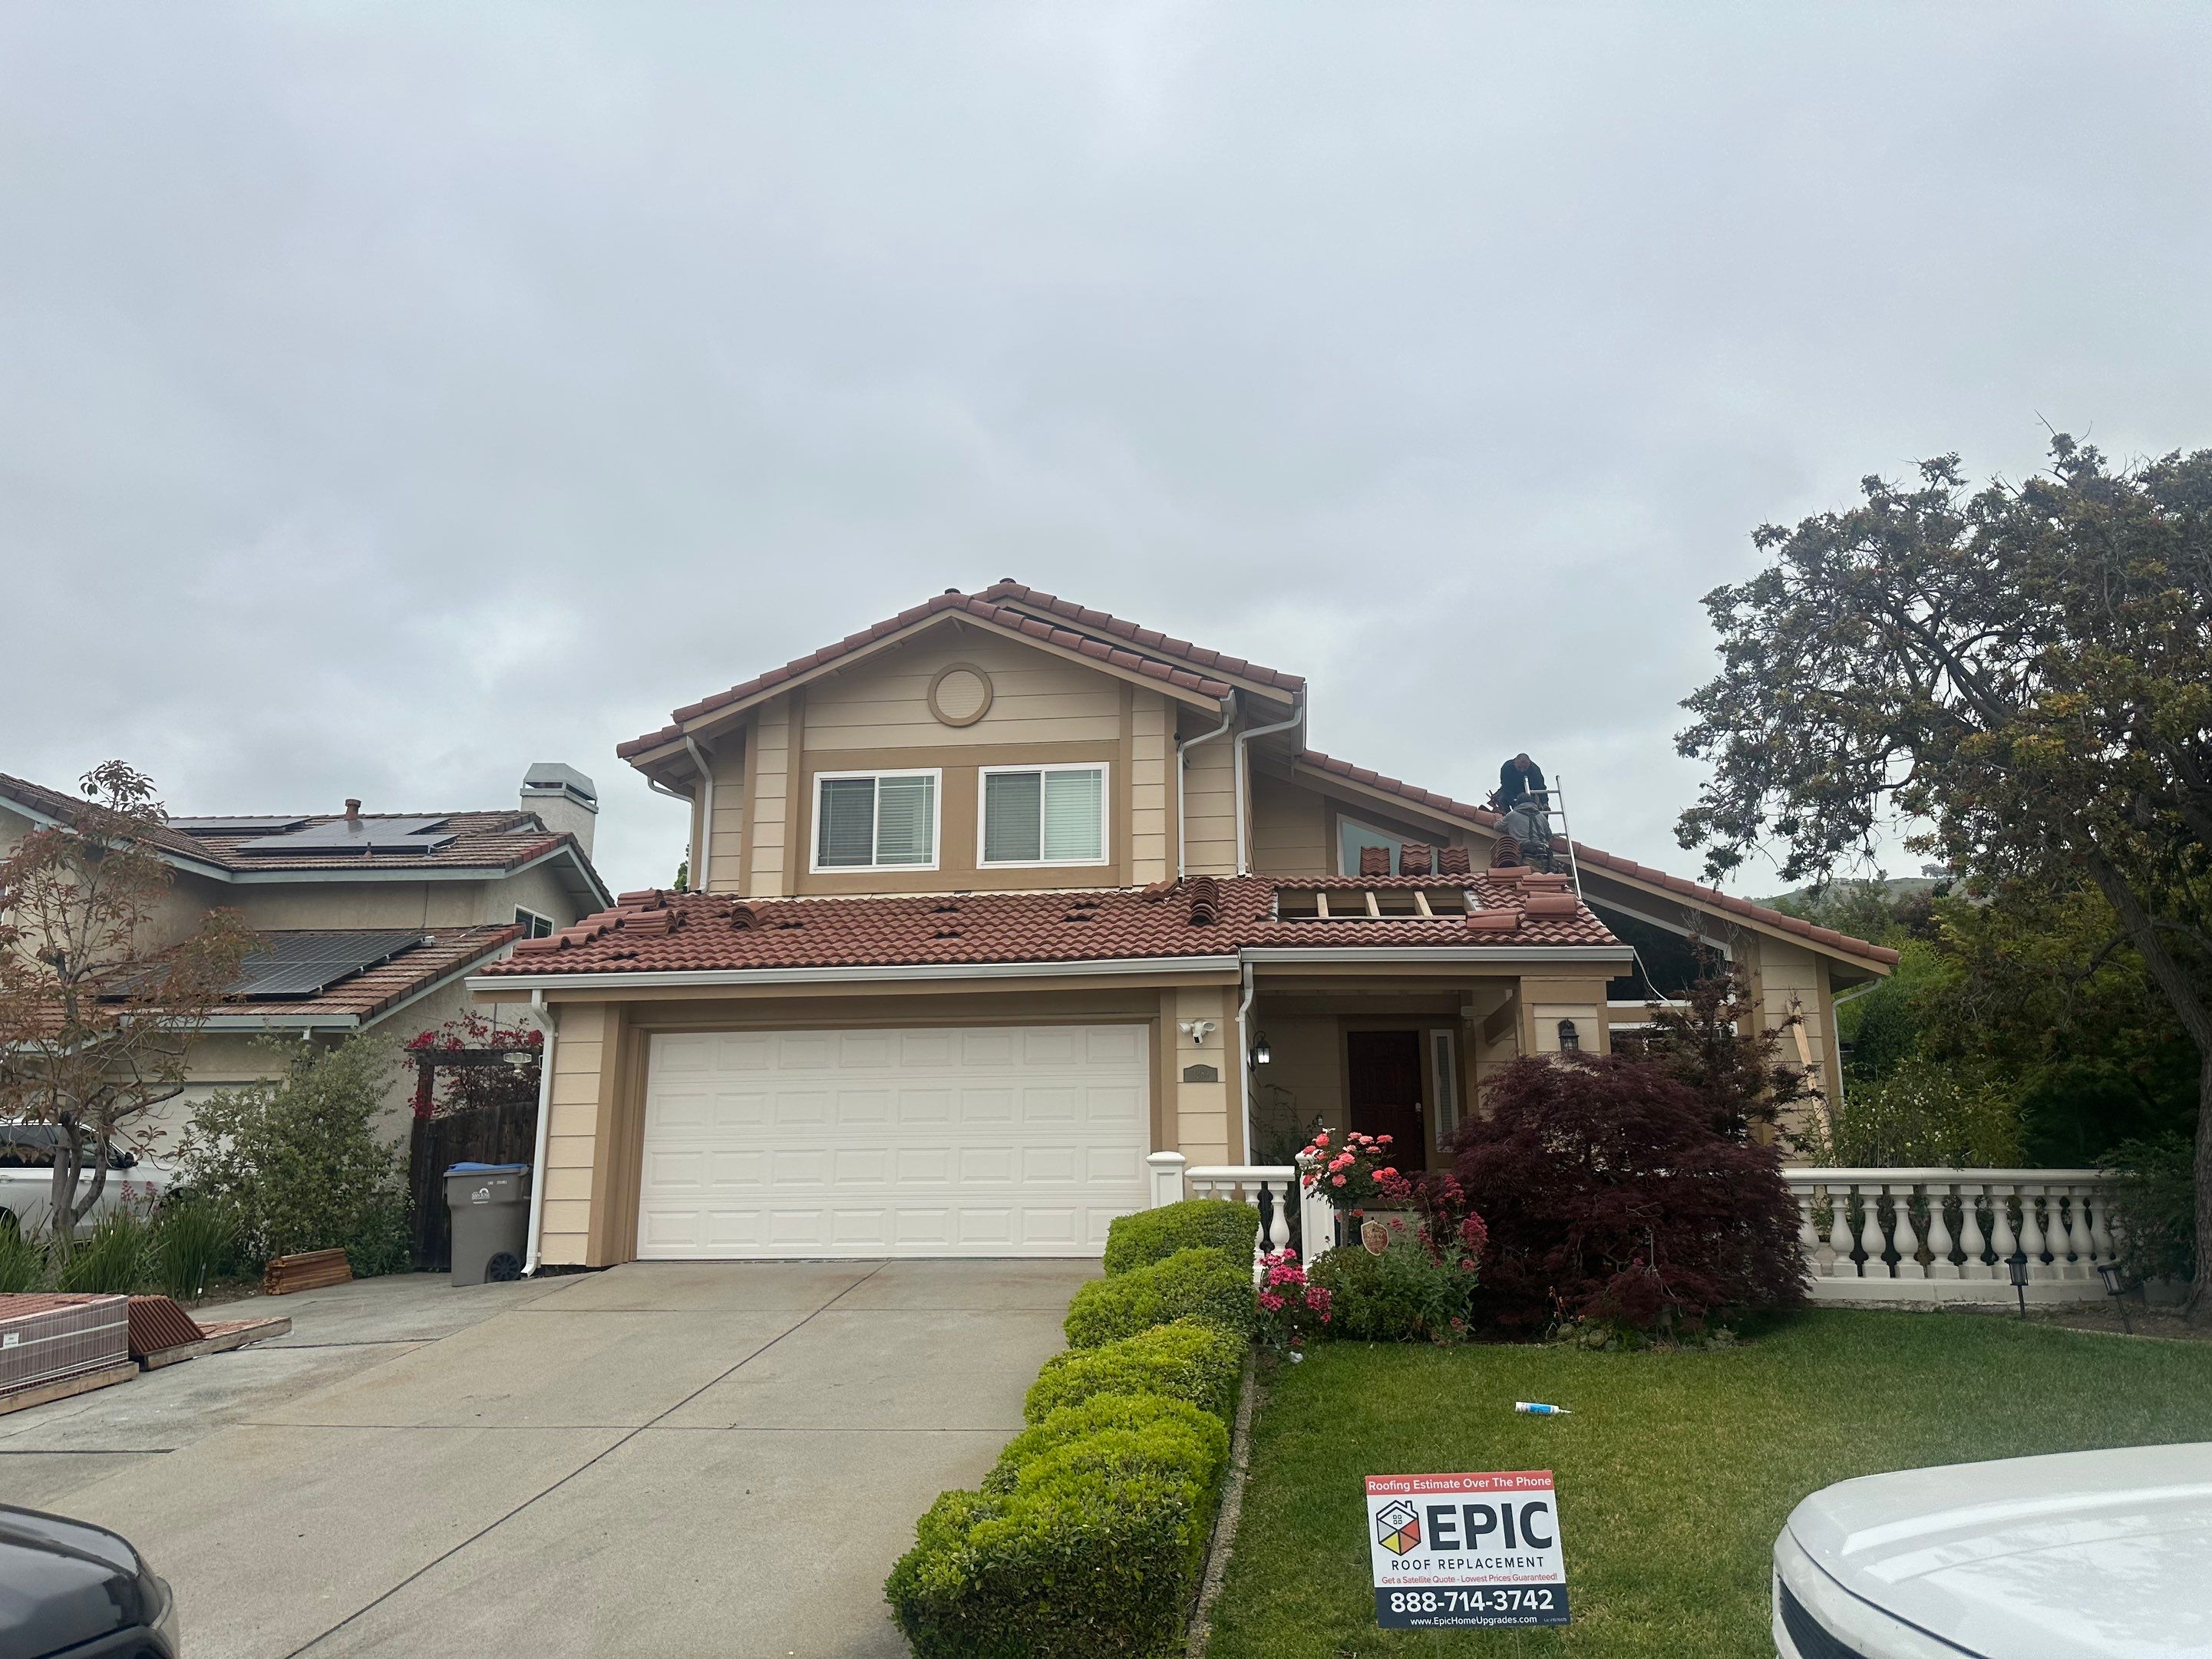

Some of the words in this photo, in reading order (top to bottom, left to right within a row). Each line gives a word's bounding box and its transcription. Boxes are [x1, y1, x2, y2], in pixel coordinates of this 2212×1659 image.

[1368, 1479, 1410, 1492] Roofing
[1413, 1479, 1460, 1490] Estimate
[1463, 1478, 1489, 1488] Over
[1492, 1477, 1514, 1487] The
[1516, 1476, 1551, 1486] Phone
[1426, 1501, 1553, 1551] EPIC
[1392, 1559, 1431, 1570] ROOF
[1438, 1556, 1544, 1569] REPLACEMENT
[1512, 1573, 1558, 1581] Guaranteed!
[1390, 1589, 1554, 1613] 888-714-3742
[1410, 1615, 1537, 1626] www.EpicHomeUpgrades.com
